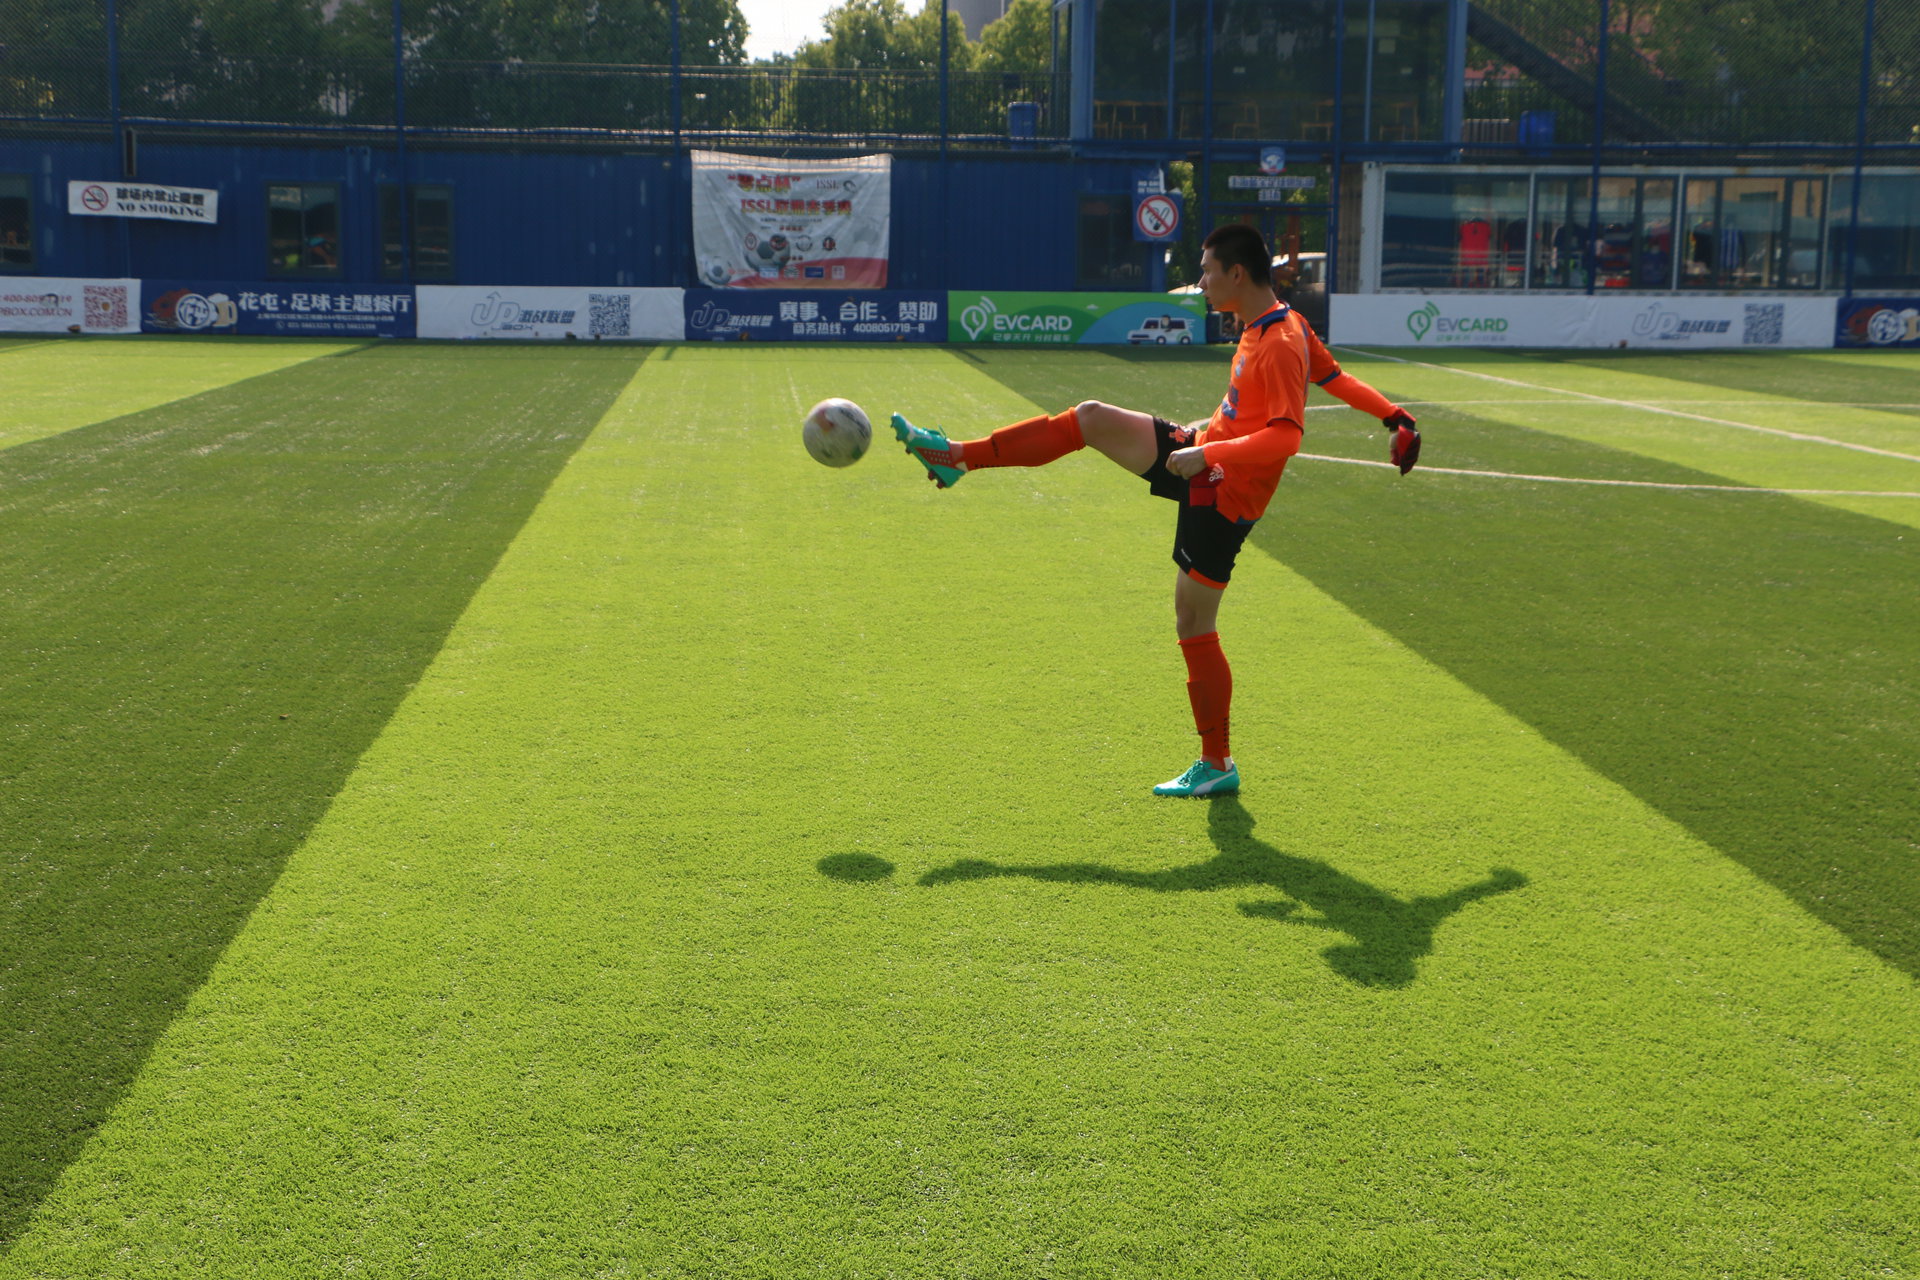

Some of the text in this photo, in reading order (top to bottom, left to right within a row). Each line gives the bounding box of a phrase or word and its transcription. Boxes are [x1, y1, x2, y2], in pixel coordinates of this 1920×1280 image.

[117, 202, 204, 217] NO SMOKING
[993, 314, 1072, 331] EVCARD
[1437, 317, 1508, 332] EVCARD
